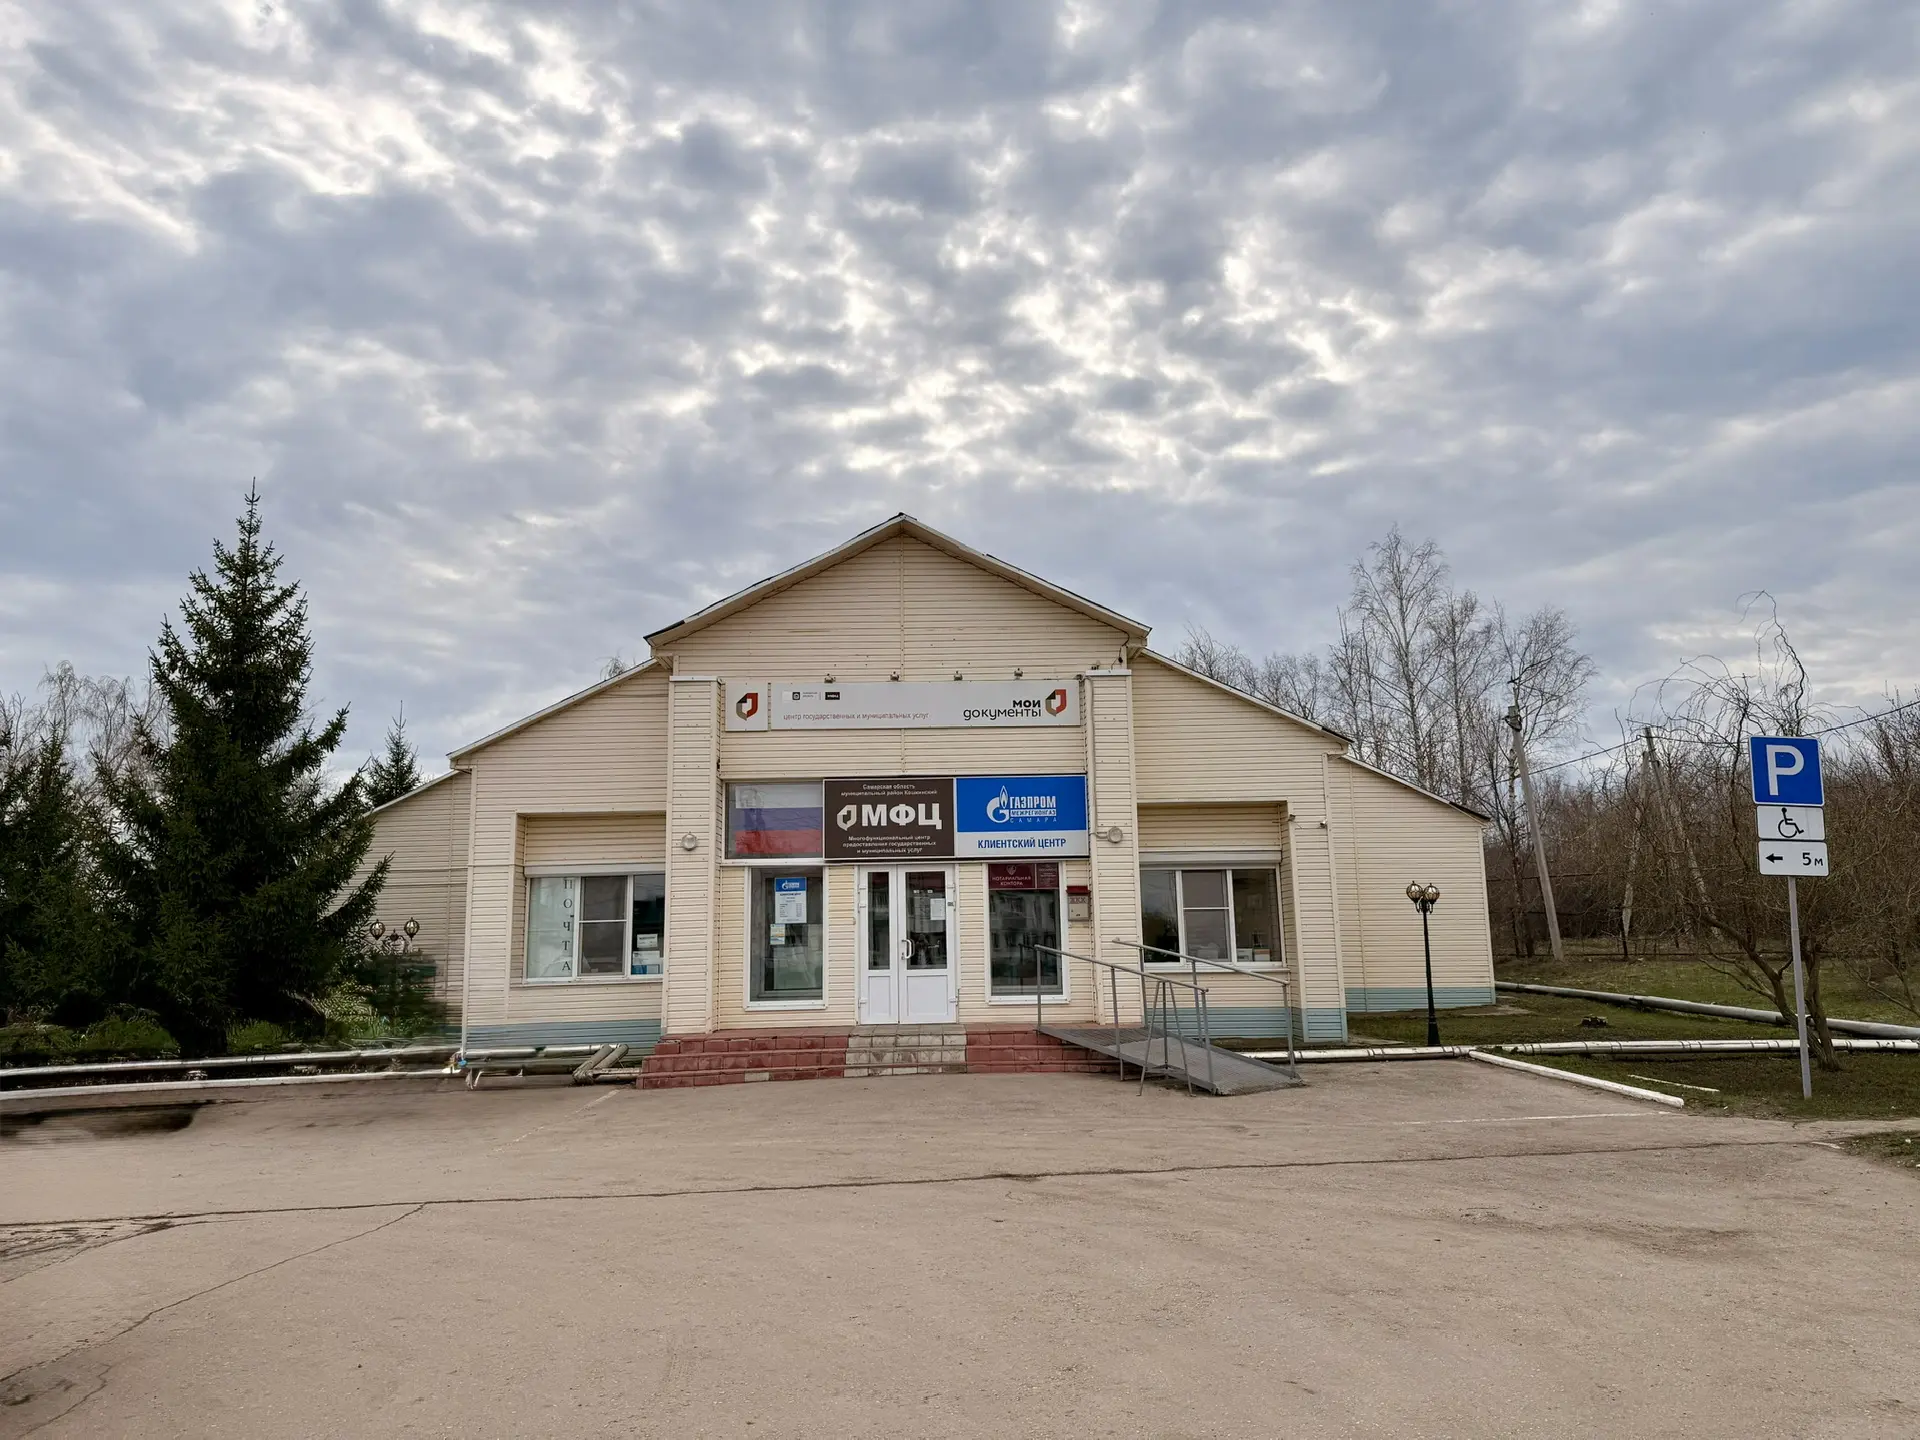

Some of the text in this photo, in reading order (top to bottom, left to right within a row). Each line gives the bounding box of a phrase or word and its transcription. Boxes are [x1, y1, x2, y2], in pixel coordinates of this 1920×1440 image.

[1012, 700, 1040, 708] мои
[912, 712, 930, 720] услуг
[963, 708, 1041, 720] документы
[1766, 744, 1804, 796] P
[1010, 796, 1056, 808] ГАЗПРОМ
[862, 803, 942, 830] МФЦ
[978, 837, 1066, 849] КЛИЕНТСКИЙ ЦЕНТР
[1802, 852, 1812, 866] 5
